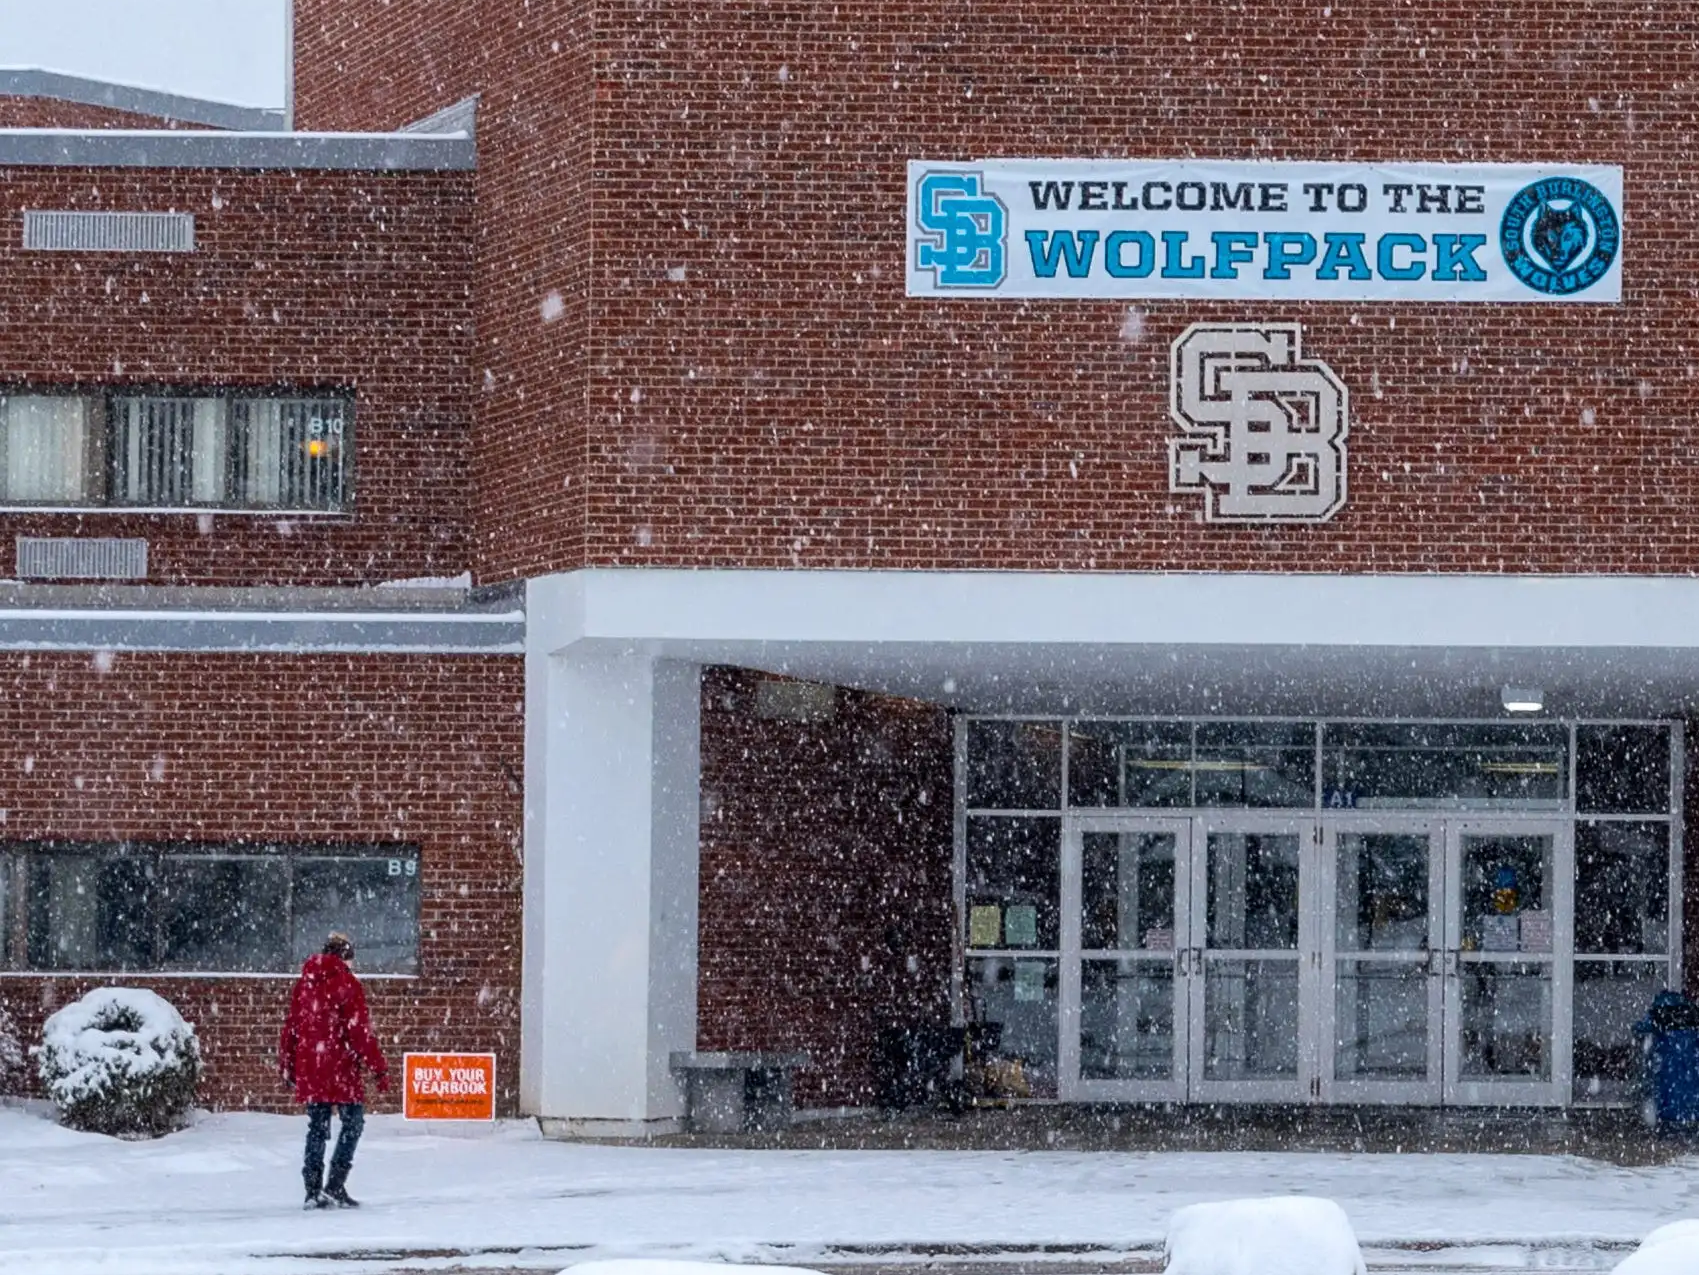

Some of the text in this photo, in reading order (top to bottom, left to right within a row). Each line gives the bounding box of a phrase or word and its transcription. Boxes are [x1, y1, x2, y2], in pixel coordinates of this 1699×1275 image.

[1028, 181, 1486, 214] WELCOME TO THE
[1505, 182, 1615, 253] SOUTH BURLINGTON
[1024, 229, 1488, 282] WOLFPACK
[1513, 254, 1606, 292] WOLVES
[412, 1081, 487, 1095] YEARBOOK
[414, 1068, 485, 1082] BUY YOUR
